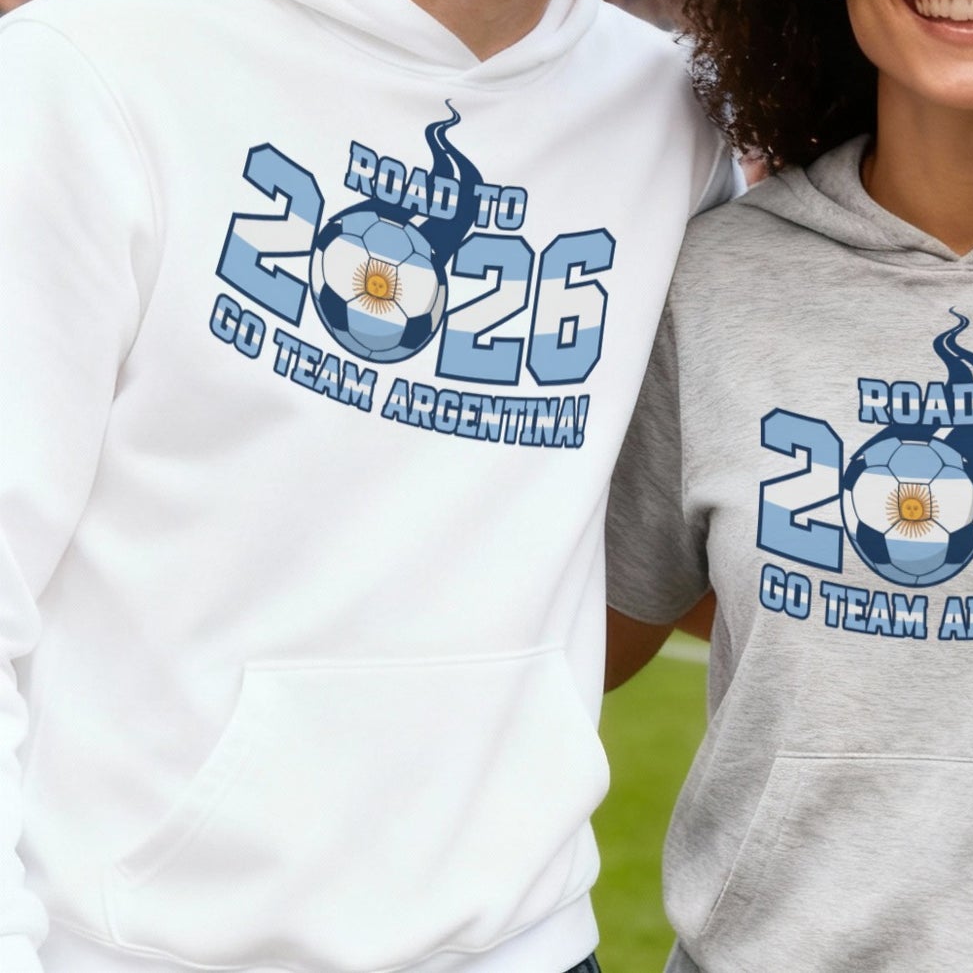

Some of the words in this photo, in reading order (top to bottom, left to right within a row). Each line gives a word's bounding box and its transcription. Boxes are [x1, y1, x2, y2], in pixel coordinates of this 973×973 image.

[344, 140, 460, 220] ROAD
[472, 182, 528, 231] TO
[209, 293, 266, 359] GO
[273, 328, 378, 412] TEAM
[381, 377, 590, 448] ARGENTINA!
[759, 563, 811, 620] GO
[820, 580, 928, 640] TEAM
